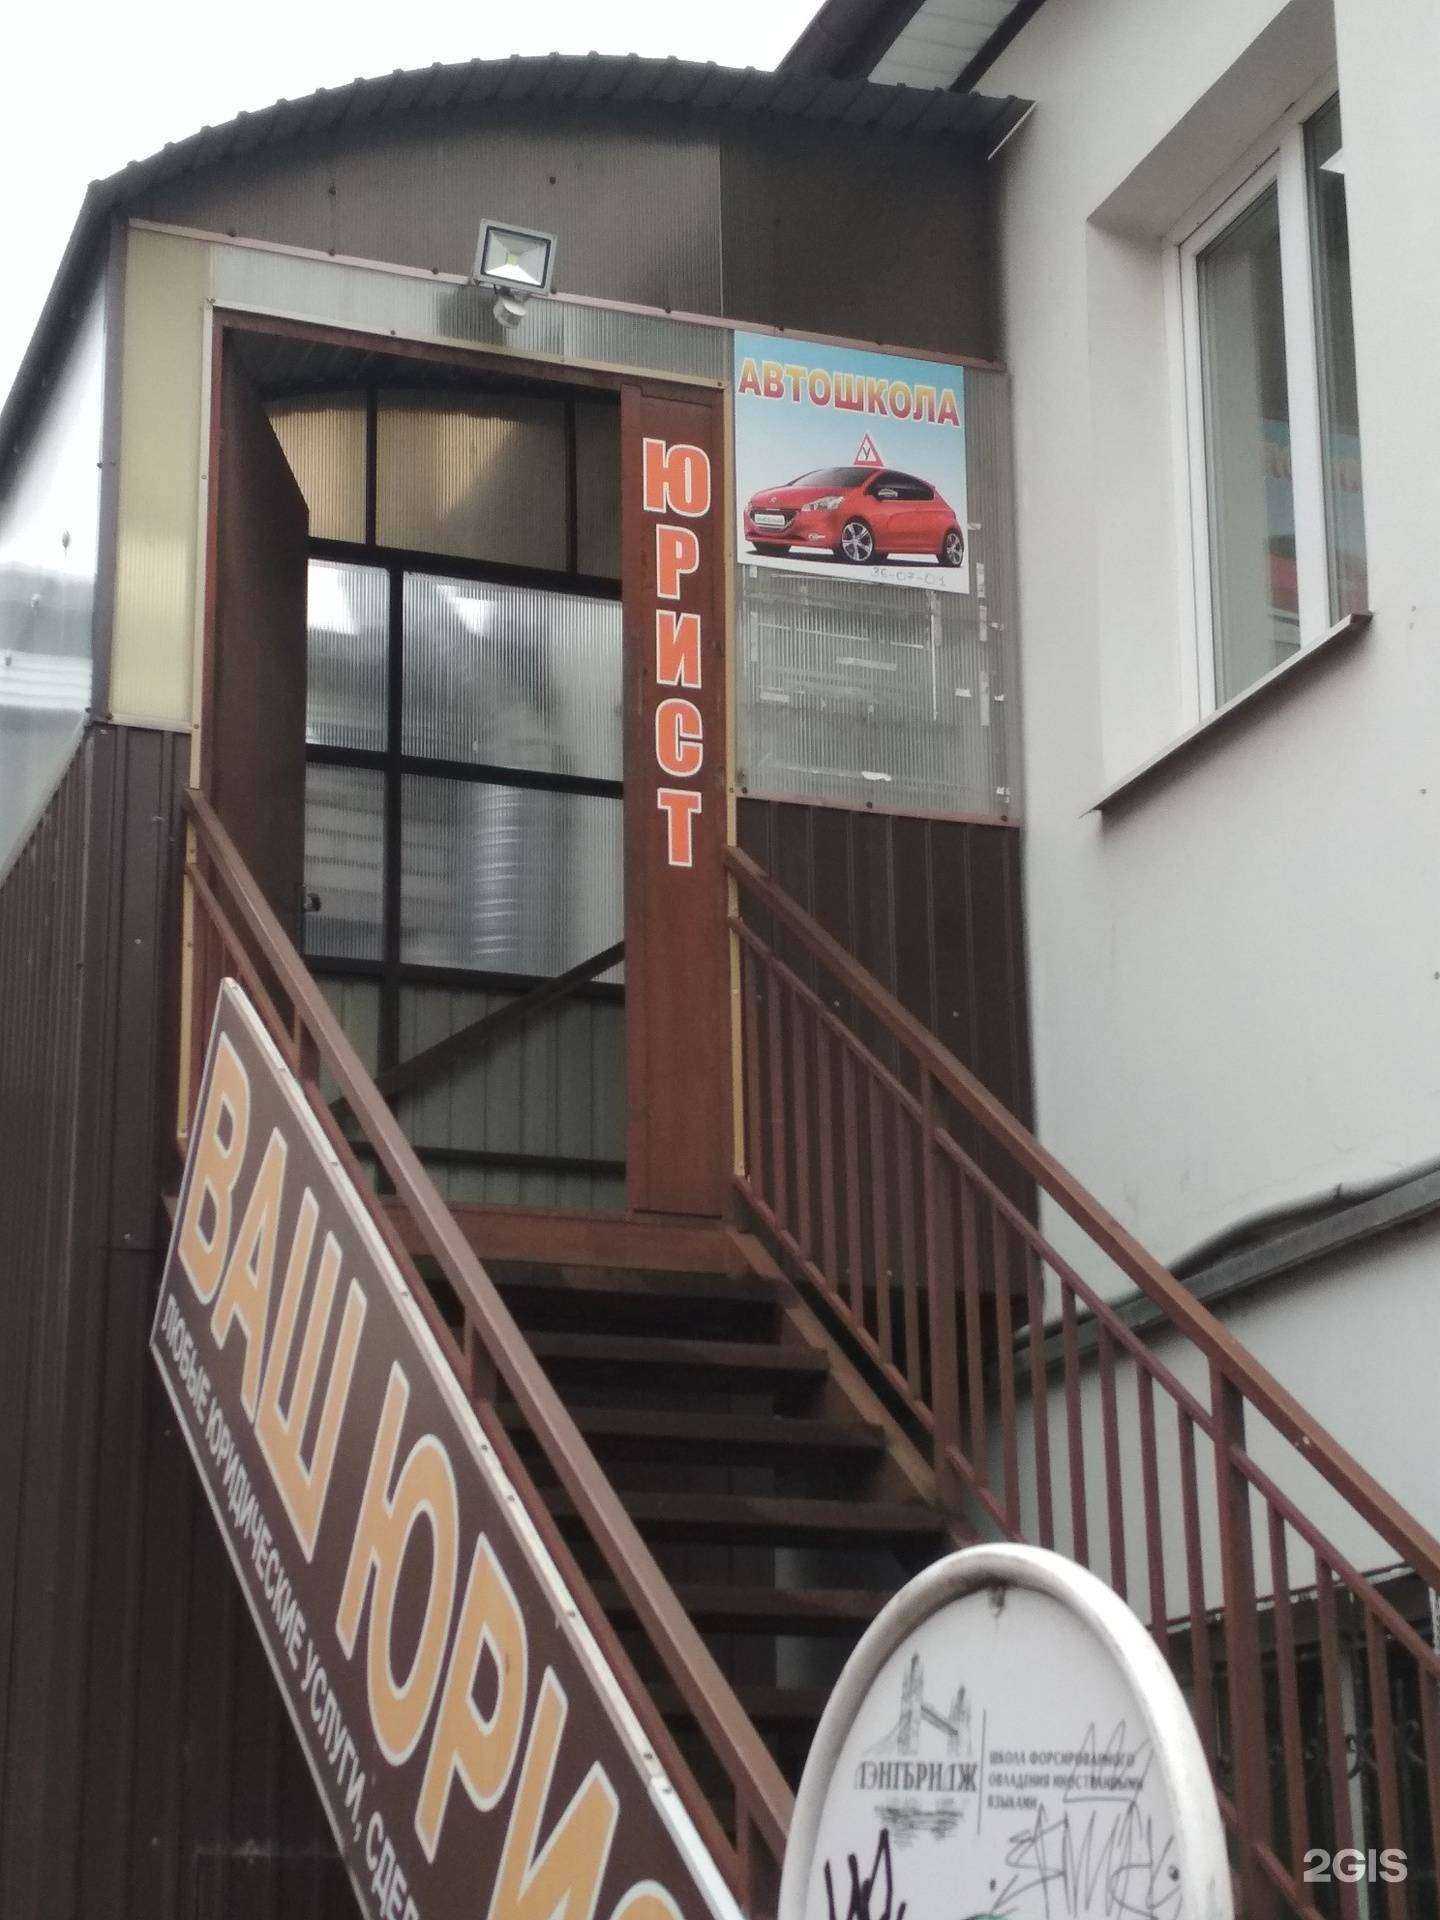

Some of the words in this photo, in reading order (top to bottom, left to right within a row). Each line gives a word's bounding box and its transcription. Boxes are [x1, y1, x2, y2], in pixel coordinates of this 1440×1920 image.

[737, 356, 960, 427] АВТОШКОЛА
[642, 437, 711, 869] ЮРИСТ
[162, 1293, 211, 1423] ЛЮБЫЕ
[204, 1396, 306, 1671] ЮРИДИЧЕСКИЕ
[300, 1638, 366, 1842] УСЛУГИ,
[178, 1029, 368, 1563] ВАШ
[335, 1359, 686, 1920] ЮРИ
